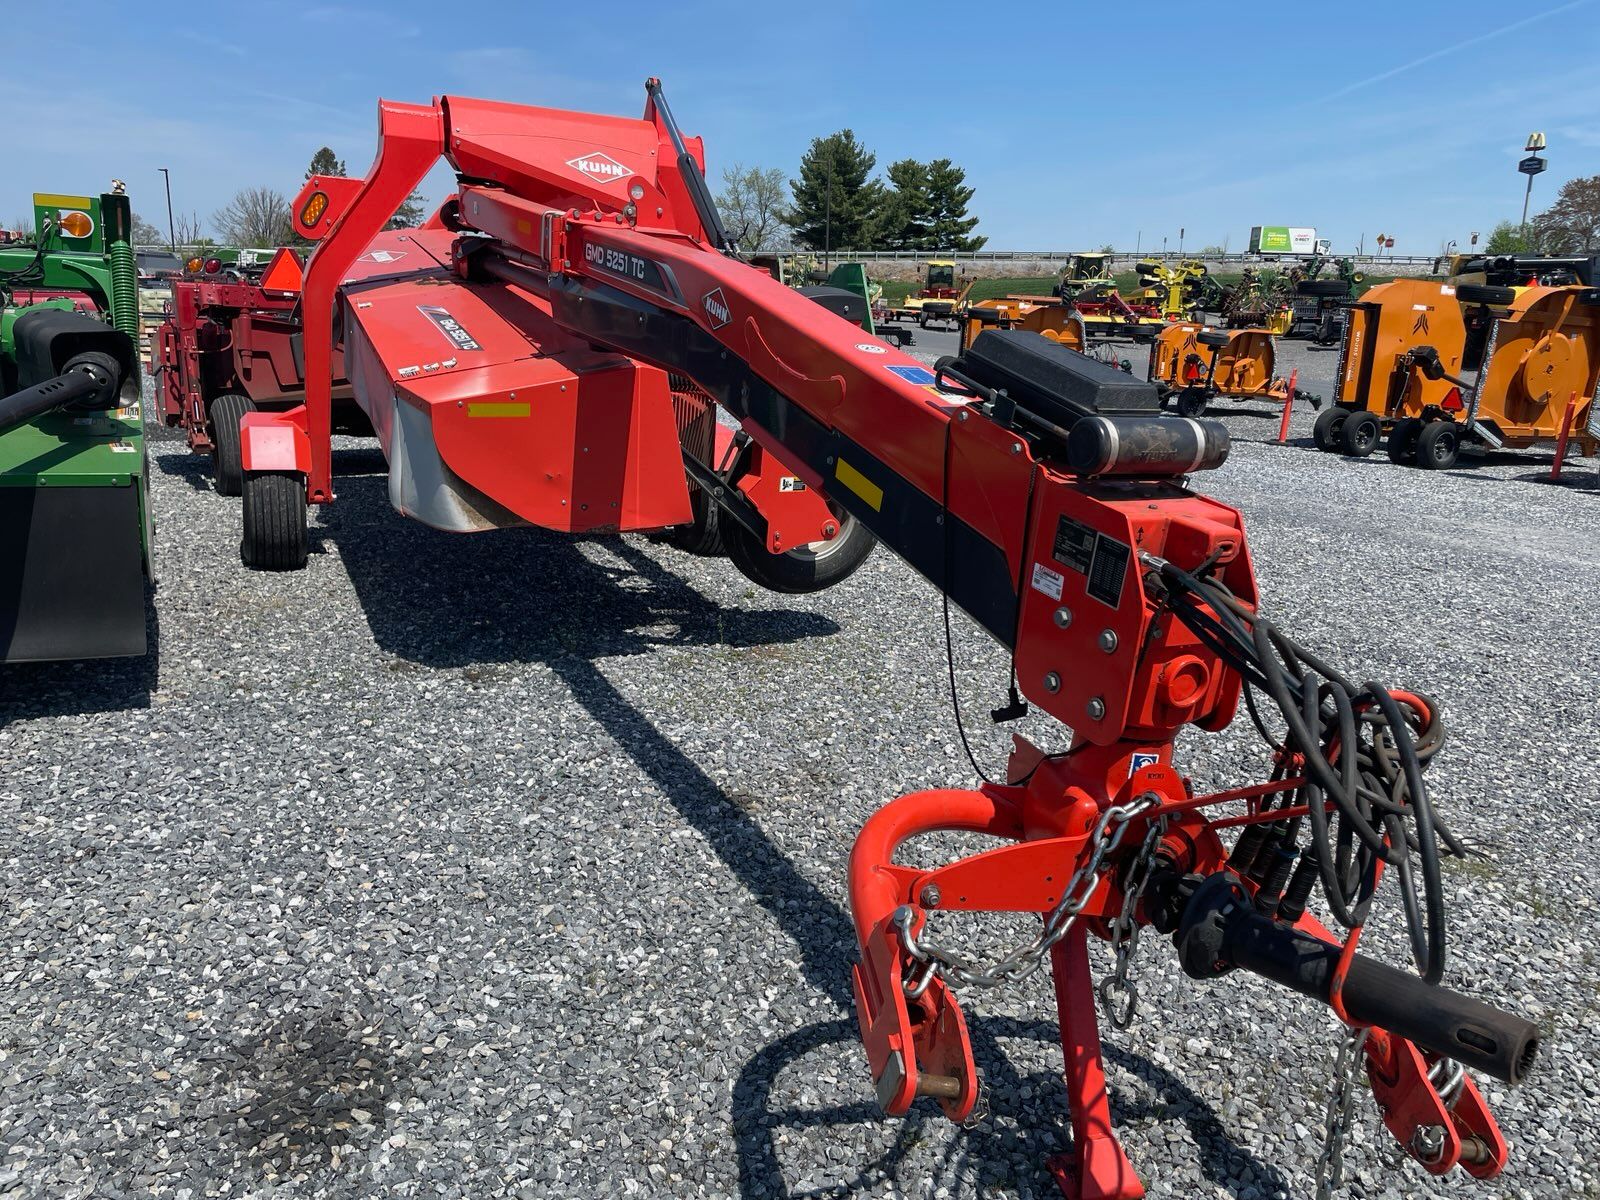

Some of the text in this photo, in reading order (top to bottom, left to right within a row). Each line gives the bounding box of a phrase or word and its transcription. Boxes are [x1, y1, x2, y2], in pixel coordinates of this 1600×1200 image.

[578, 160, 623, 177] KUHN
[585, 243, 645, 280] GMD 5251 TC
[706, 296, 728, 323] KUHN
